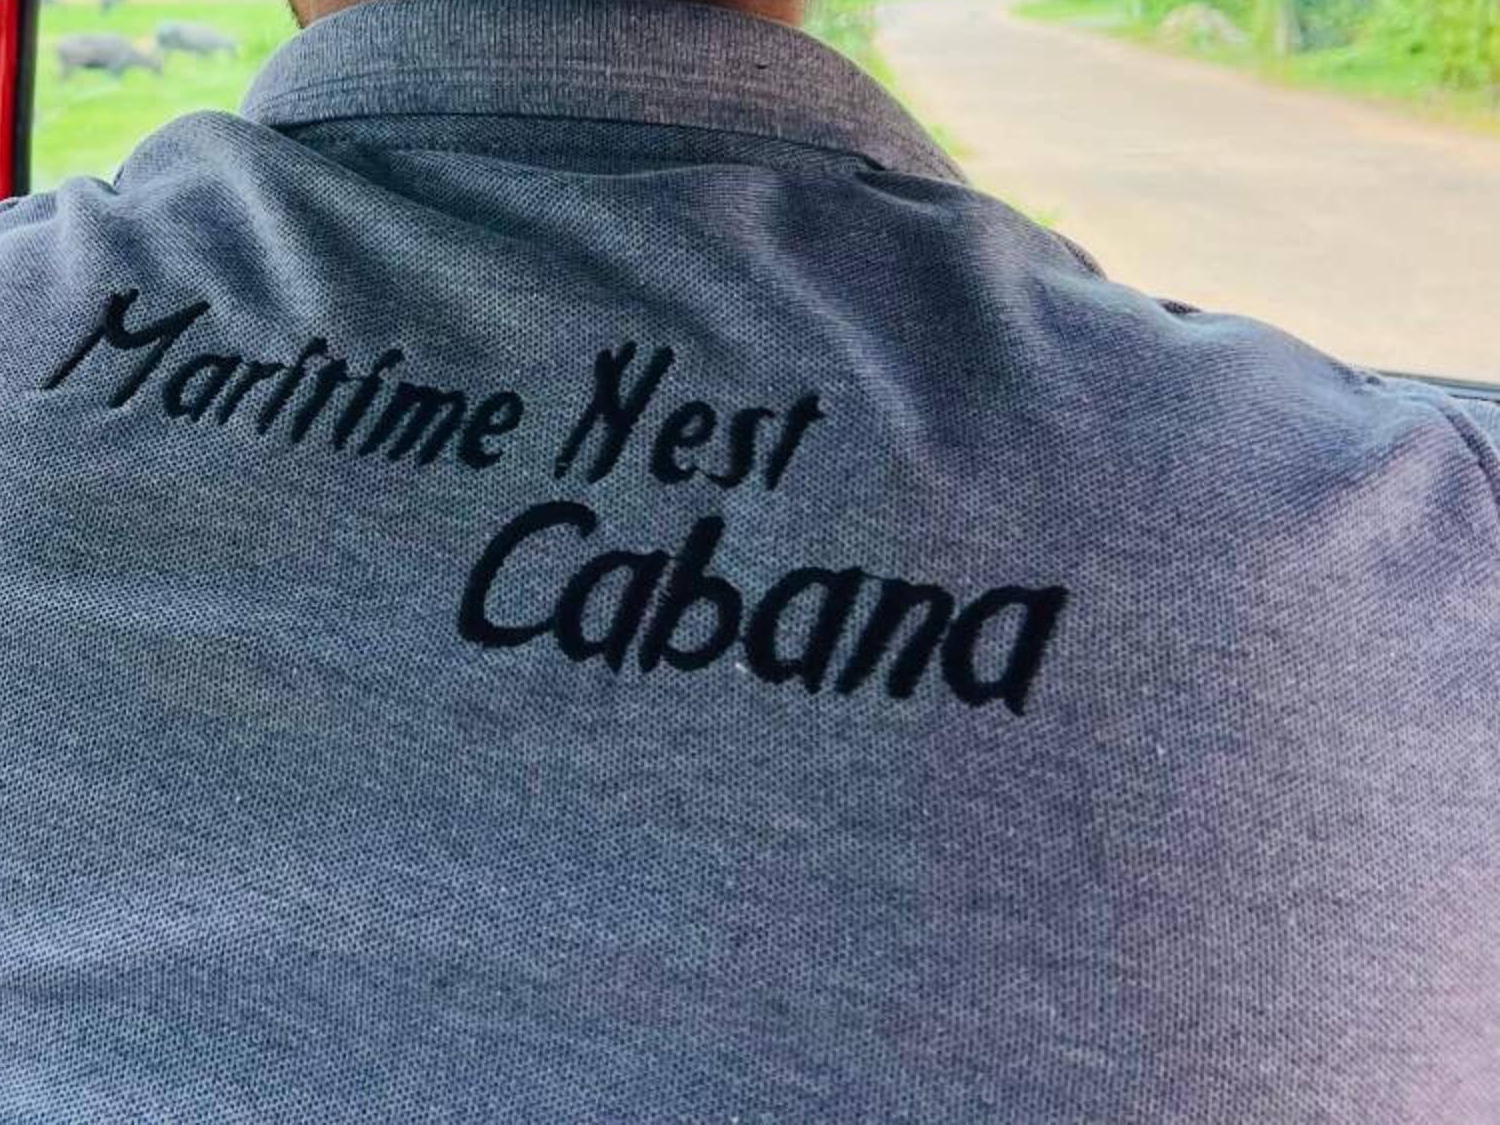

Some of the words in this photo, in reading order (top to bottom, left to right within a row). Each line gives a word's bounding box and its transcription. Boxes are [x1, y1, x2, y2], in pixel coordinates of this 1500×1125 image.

[43, 289, 524, 472] Maritime
[554, 340, 826, 491] Nest
[457, 499, 1070, 718] Cabana
